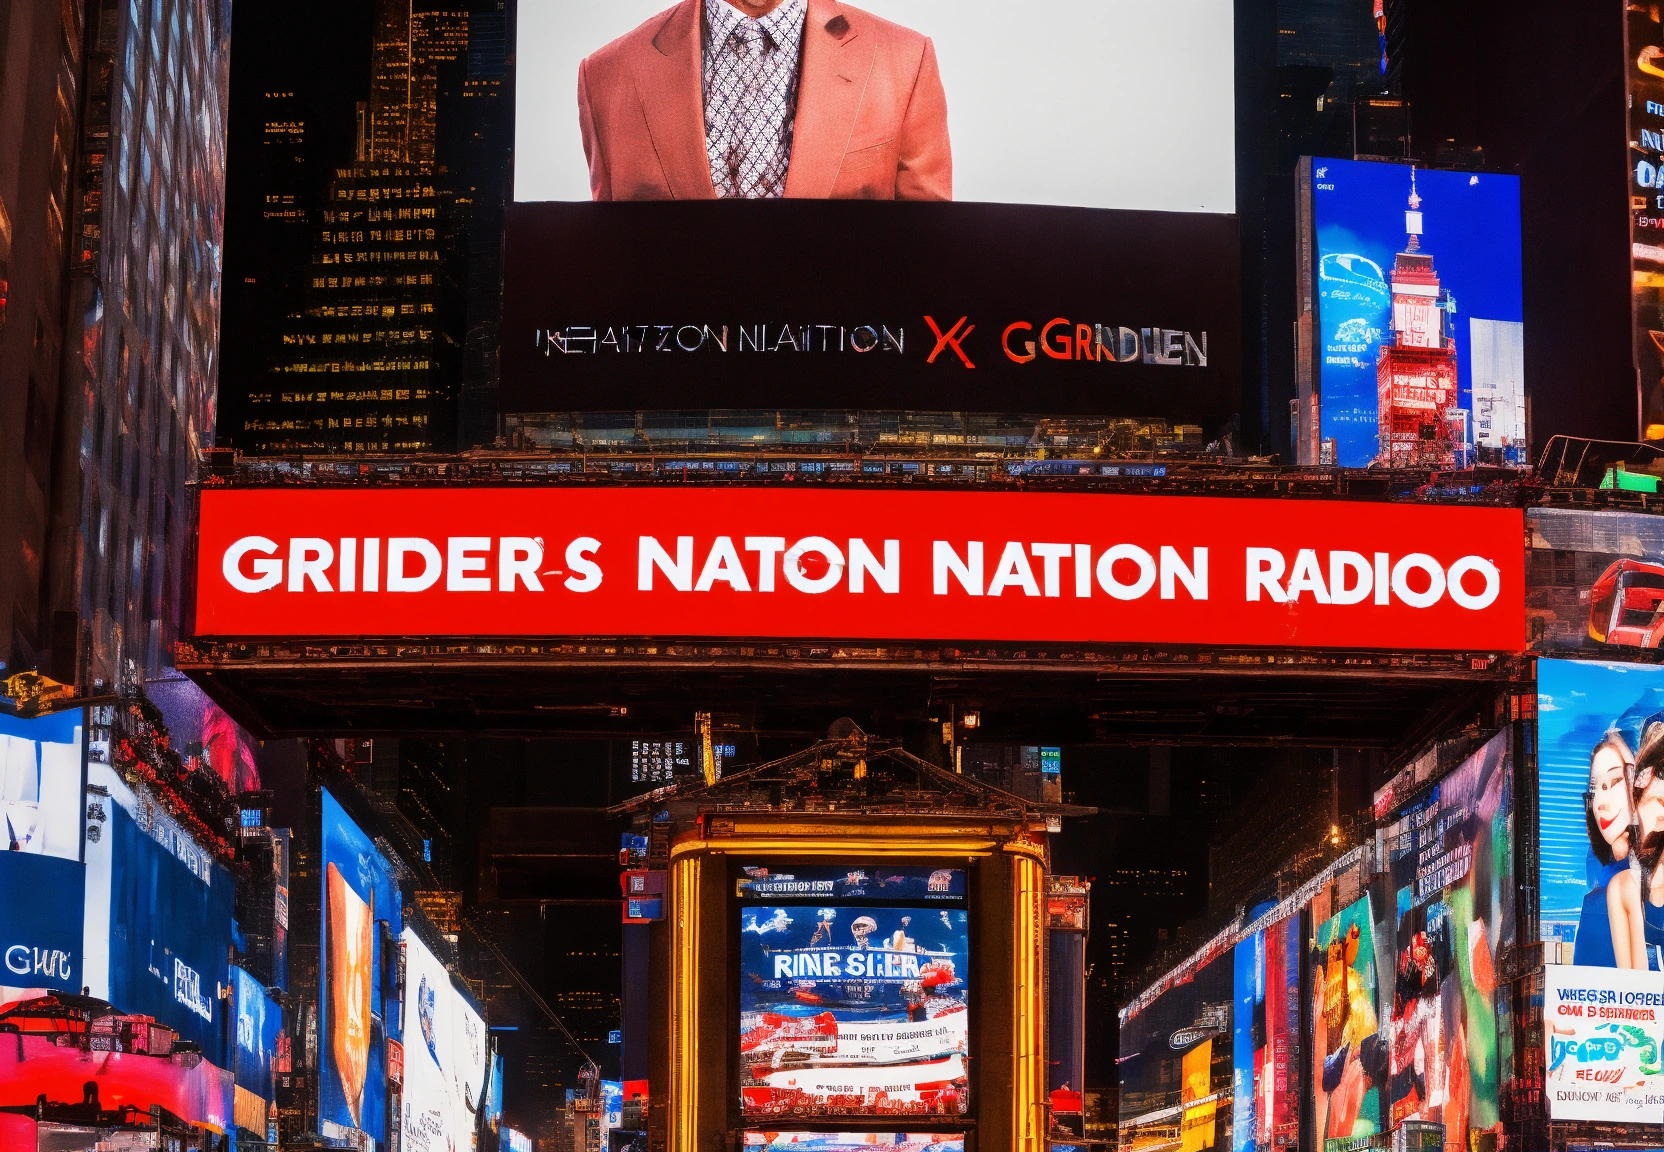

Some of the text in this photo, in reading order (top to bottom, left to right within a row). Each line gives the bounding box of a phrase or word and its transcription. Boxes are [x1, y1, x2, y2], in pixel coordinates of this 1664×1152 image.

[637, 535, 900, 594] NATON
[932, 540, 1209, 601] NATION
[1245, 546, 1502, 611] RADIOO
